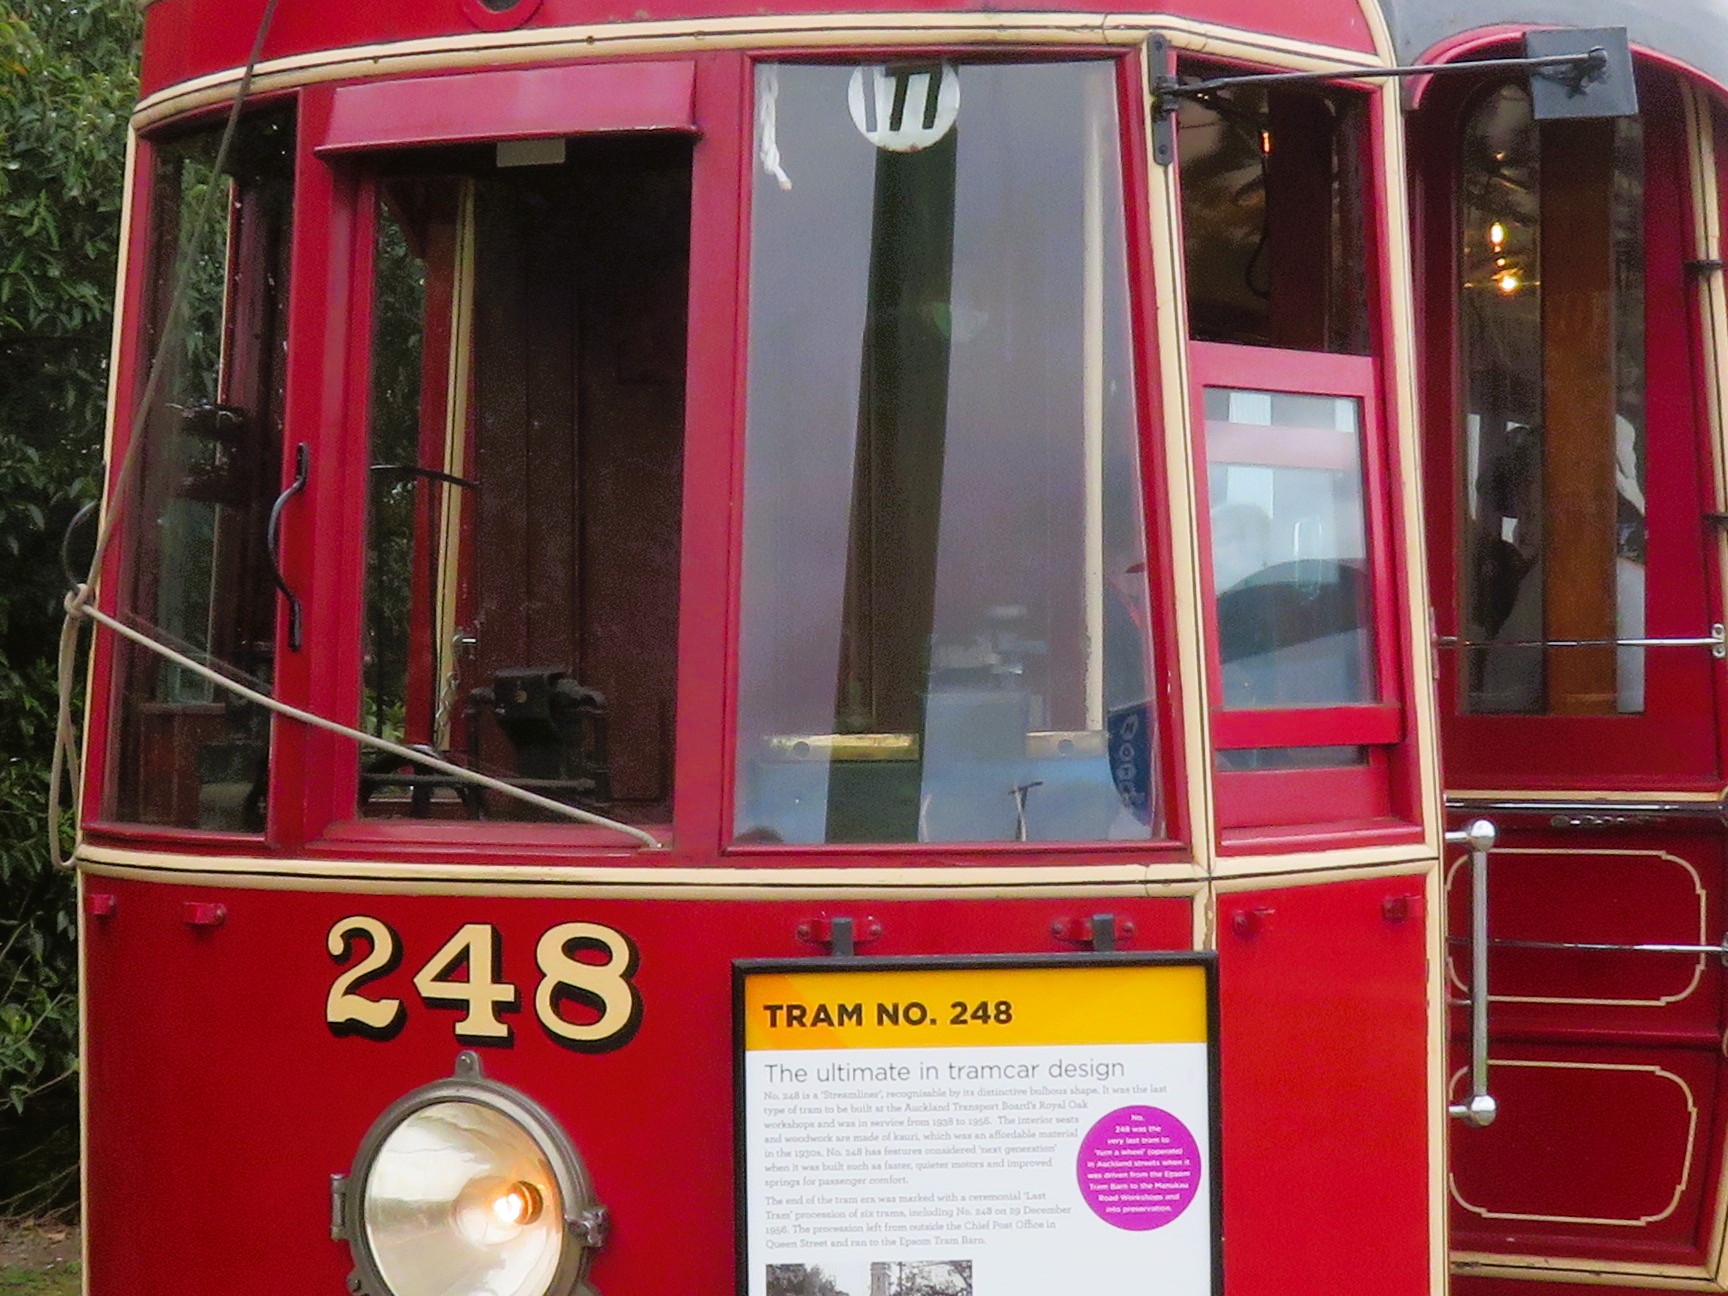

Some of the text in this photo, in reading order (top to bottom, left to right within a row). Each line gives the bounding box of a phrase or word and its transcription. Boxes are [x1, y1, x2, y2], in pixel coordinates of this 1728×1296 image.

[326, 915, 643, 1054] 248
[763, 1000, 1013, 1028] TRAM NO. 248
[764, 1059, 1125, 1084] The ultimate in tramcar design
[821, 1089, 884, 1101] 'Streamliner',
[886, 1088, 946, 1101] recognisable
[963, 1088, 975, 1097] its
[977, 1087, 1027, 1097] distinctive
[1029, 1086, 1067, 1096] bulbous
[1070, 1086, 1100, 1098] shape.
[1133, 1085, 1147, 1094] the
[1149, 1084, 1167, 1094] last
[763, 1105, 785, 1117] type
[799, 1105, 822, 1114] tram
[850, 1103, 872, 1113] built
[886, 1103, 902, 1113] the
[904, 1102, 950, 1112] Auckland
[952, 1101, 999, 1114] Transport
[1001, 1101, 1036, 1111] Board's
[1039, 1100, 1066, 1113] Royal
[1068, 1100, 1088, 1110] Oak
[763, 1119, 815, 1131] workshops
[817, 1118, 835, 1128] and
[870, 1117, 905, 1127] service
[907, 1117, 930, 1127] from
[998, 1115, 1015, 1125] The
[1017, 1116, 1053, 1125] interior
[1055, 1115, 1079, 1124] seats
[764, 1133, 782, 1143] and
[784, 1133, 834, 1143] woodwork
[853, 1132, 880, 1142] made
[893, 1131, 920, 1142] kauri,
[923, 1131, 951, 1141] which
[989, 1129, 1036, 1140] affordable
[1038, 1129, 1078, 1139] material
[776, 1148, 792, 1157] the
[865, 1146, 882, 1156] has
[884, 1146, 922, 1156] features
[924, 1145, 976, 1155] considered
[978, 1144, 1002, 1154] 'next
[1004, 1143, 1057, 1156] generation'
[764, 1162, 790, 1172] when
[822, 1161, 844, 1171] built
[847, 1161, 869, 1170] such
[884, 1160, 913, 1171] faster,
[915, 1159, 949, 1172] quieter
[951, 1160, 984, 1169] motors
[987, 1158, 1005, 1168] and
[1007, 1158, 1053, 1170] improved
[764, 1175, 909, 1189] springs for passenger comfort.
[765, 1196, 783, 1206] The
[785, 1196, 803, 1205] end
[817, 1195, 833, 1205] the
[835, 1196, 858, 1204] tram
[899, 1193, 935, 1203] marked
[937, 1193, 958, 1203] with
[969, 1192, 1021, 1202] ceremonial
[1023, 1191, 1046, 1201] 'Last
